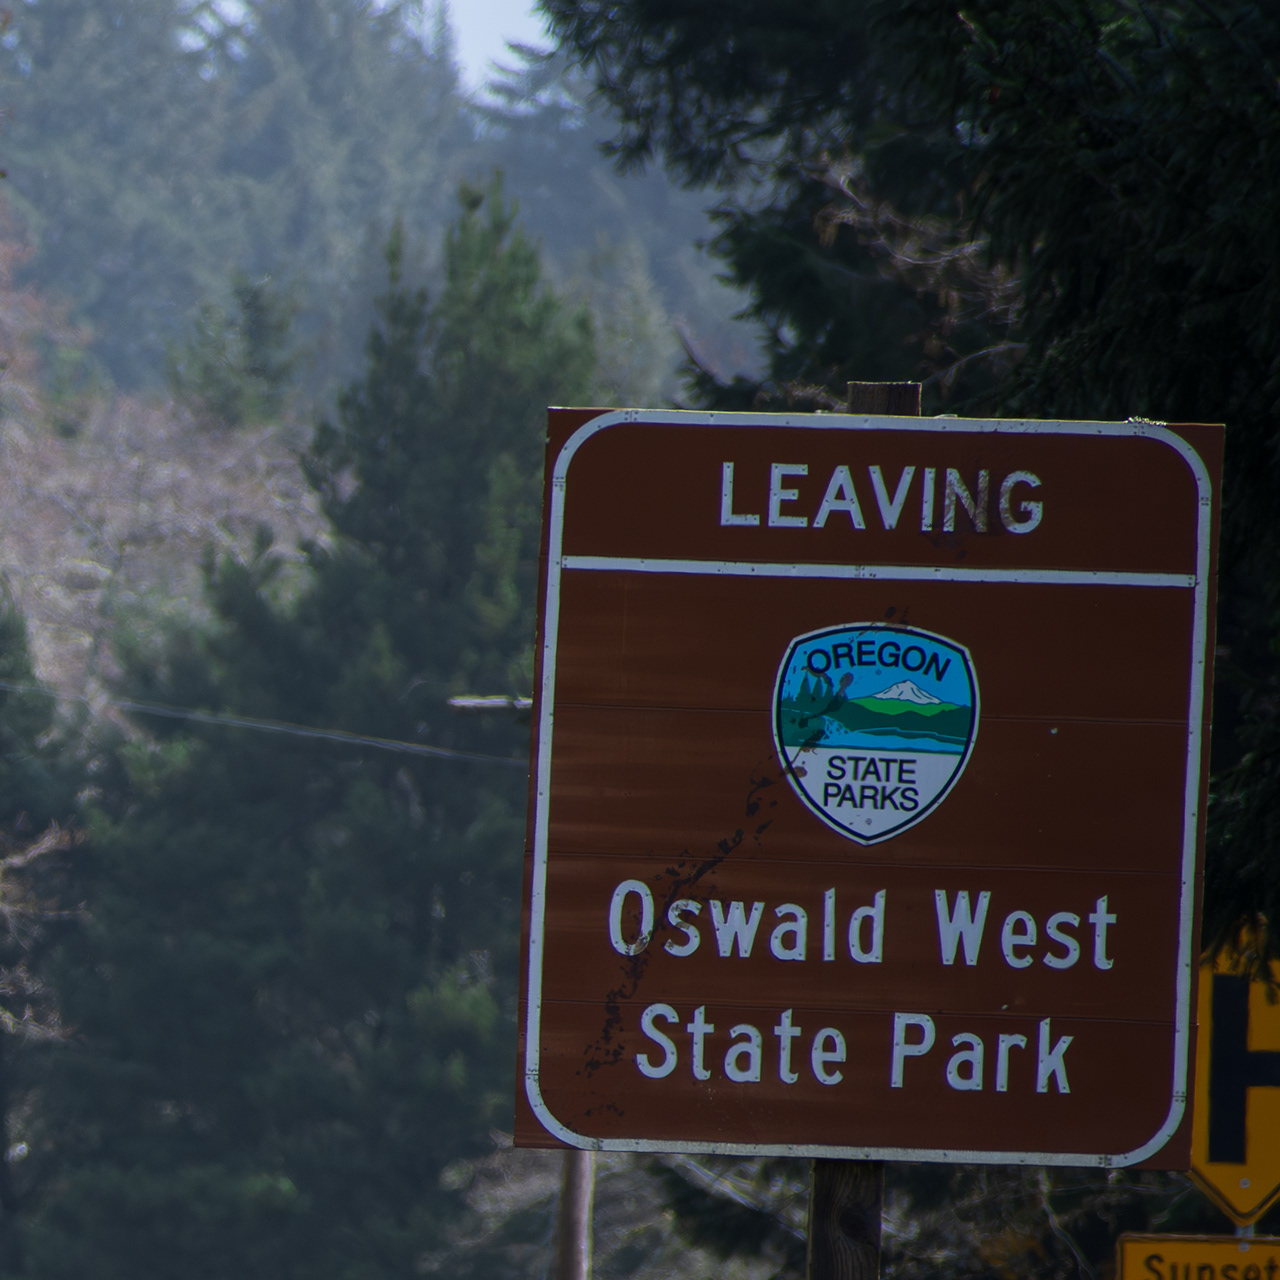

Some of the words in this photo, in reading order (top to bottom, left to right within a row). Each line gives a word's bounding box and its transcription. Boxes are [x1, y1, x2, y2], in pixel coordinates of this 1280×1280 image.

[720, 460, 1043, 533] LEAVING
[806, 640, 952, 682] OREGON
[823, 782, 920, 812] PARKS
[826, 755, 917, 785] STATE
[608, 879, 886, 963] Oswald
[935, 888, 1118, 970] West
[636, 1002, 847, 1085] State
[890, 1012, 1075, 1094] Park
